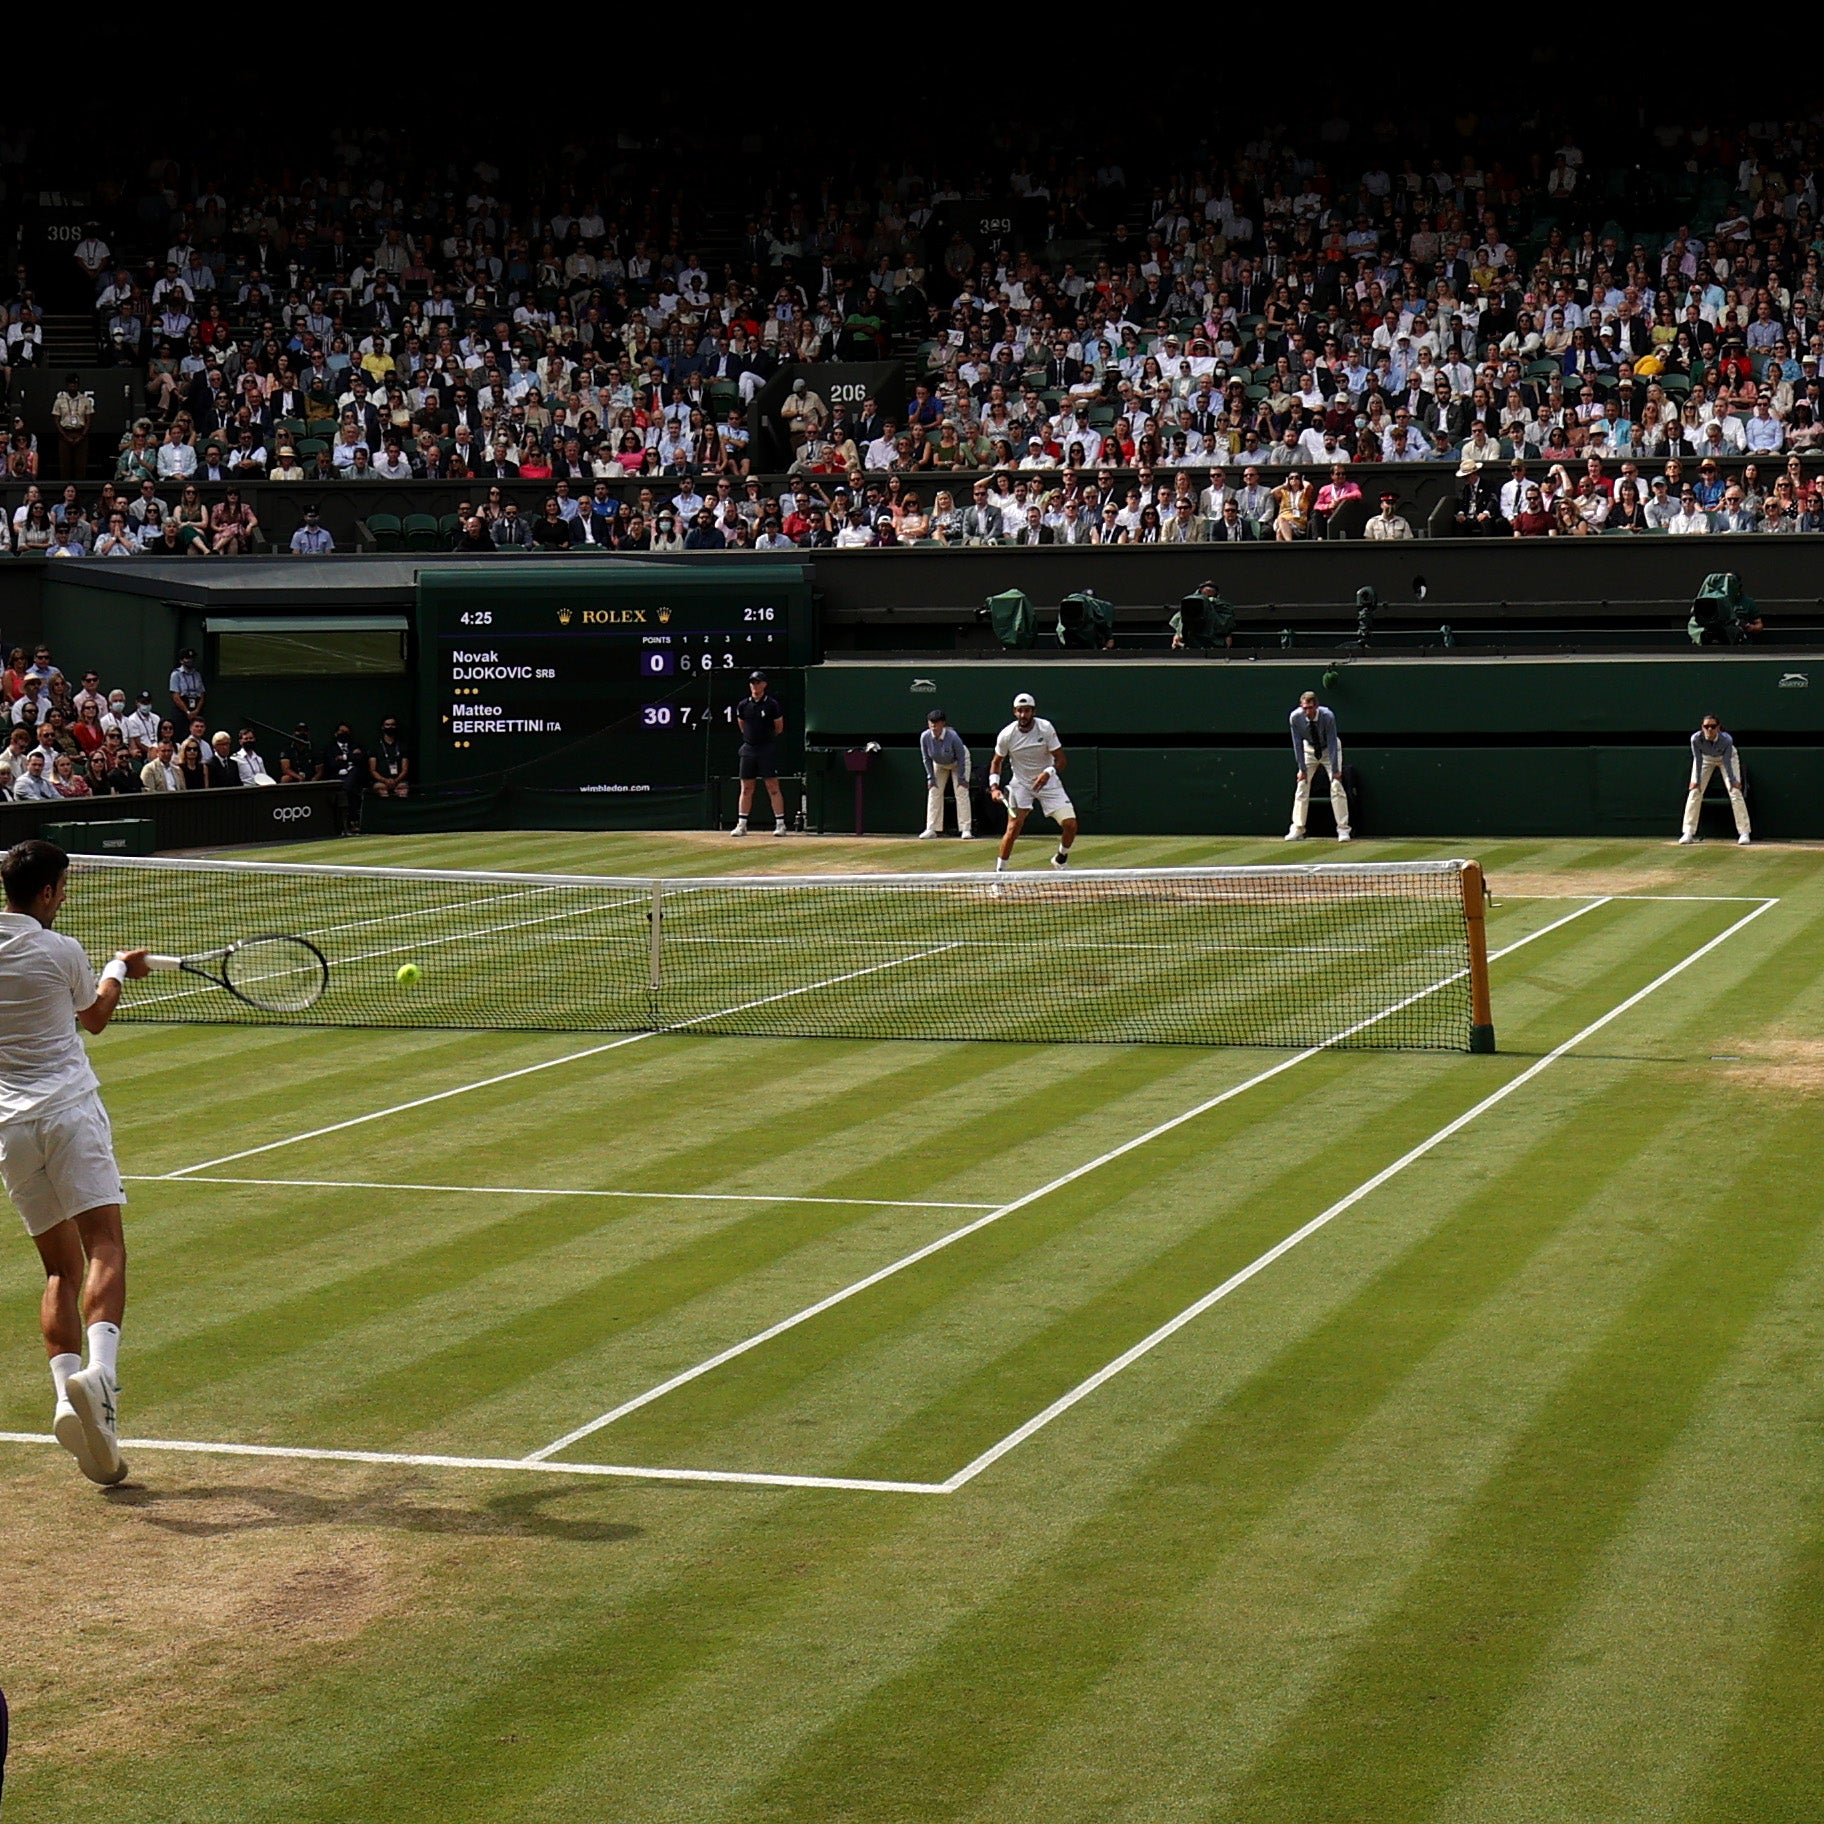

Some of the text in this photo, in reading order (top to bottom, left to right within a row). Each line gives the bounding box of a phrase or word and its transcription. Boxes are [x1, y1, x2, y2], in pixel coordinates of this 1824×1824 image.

[830, 384, 866, 402] 206
[460, 611, 493, 625] 4:25
[582, 609, 647, 624] ROLEX
[743, 607, 775, 621] 2:16
[642, 636, 672, 644] POINTS
[725, 635, 730, 643] 3
[452, 650, 499, 663] Novak
[650, 653, 734, 671] 0 6 6 3
[453, 666, 556, 680] DJOKOVIC SRB
[452, 704, 502, 716] Matteo
[644, 707, 671, 724] 30
[680, 707, 691, 724] 7
[723, 706, 732, 723] 1
[452, 719, 562, 733] BERRETTINI ITA
[579, 784, 651, 792] wimbledon.com
[272, 805, 312, 822] oppo
